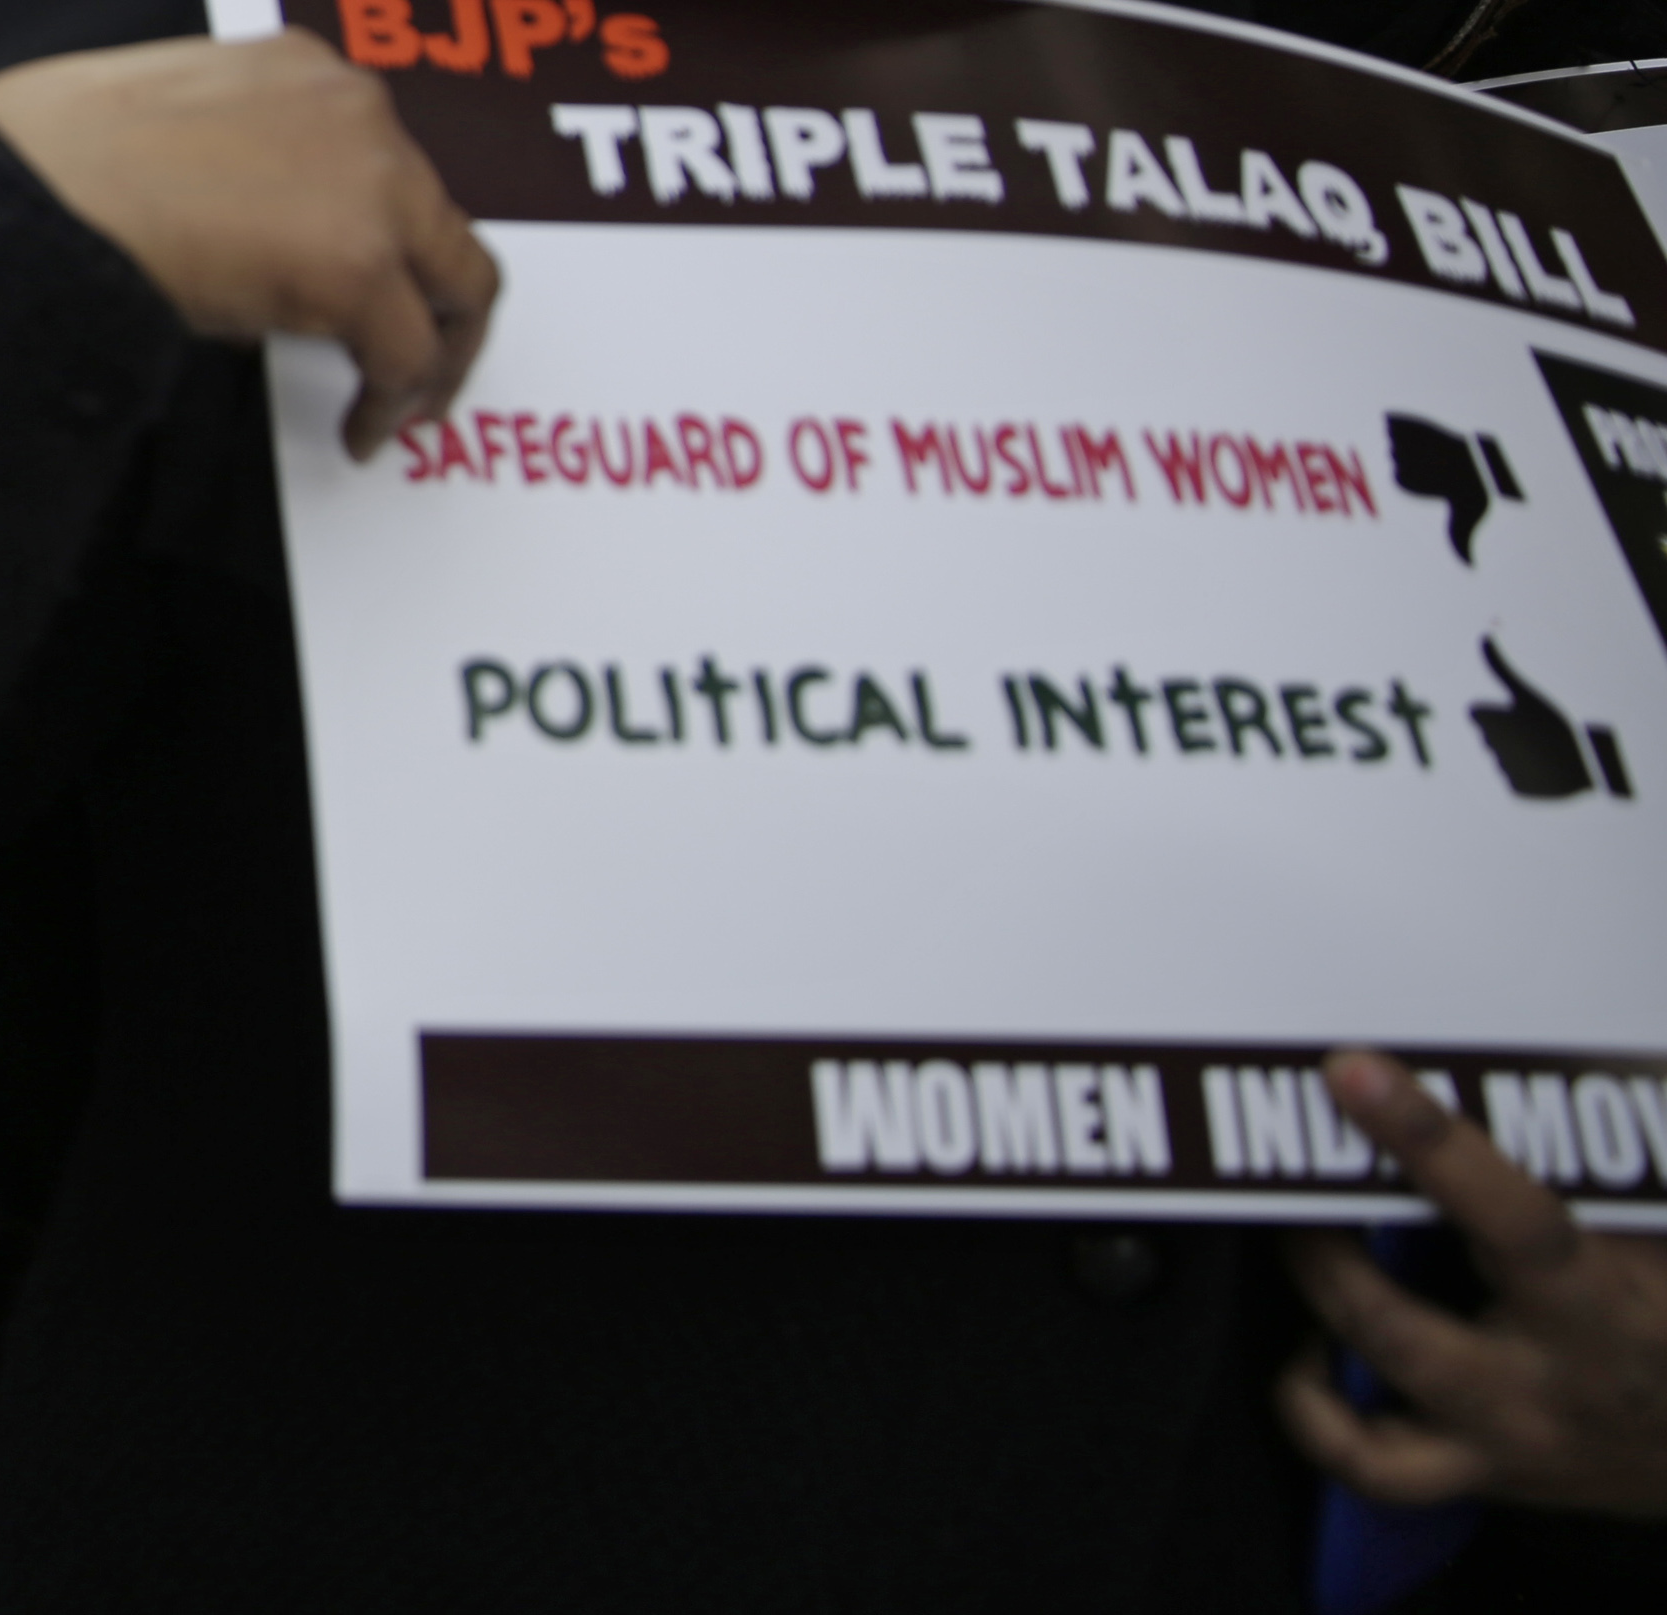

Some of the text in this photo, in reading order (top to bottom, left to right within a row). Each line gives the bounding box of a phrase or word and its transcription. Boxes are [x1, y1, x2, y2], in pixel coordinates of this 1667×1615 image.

[551, 102, 1636, 325] TRIPLE TALAQ BILL
[399, 411, 1379, 520] SAFEGUARD OF MUSLIM WOMEN
[810, 1058, 1173, 1176] WOMEN
